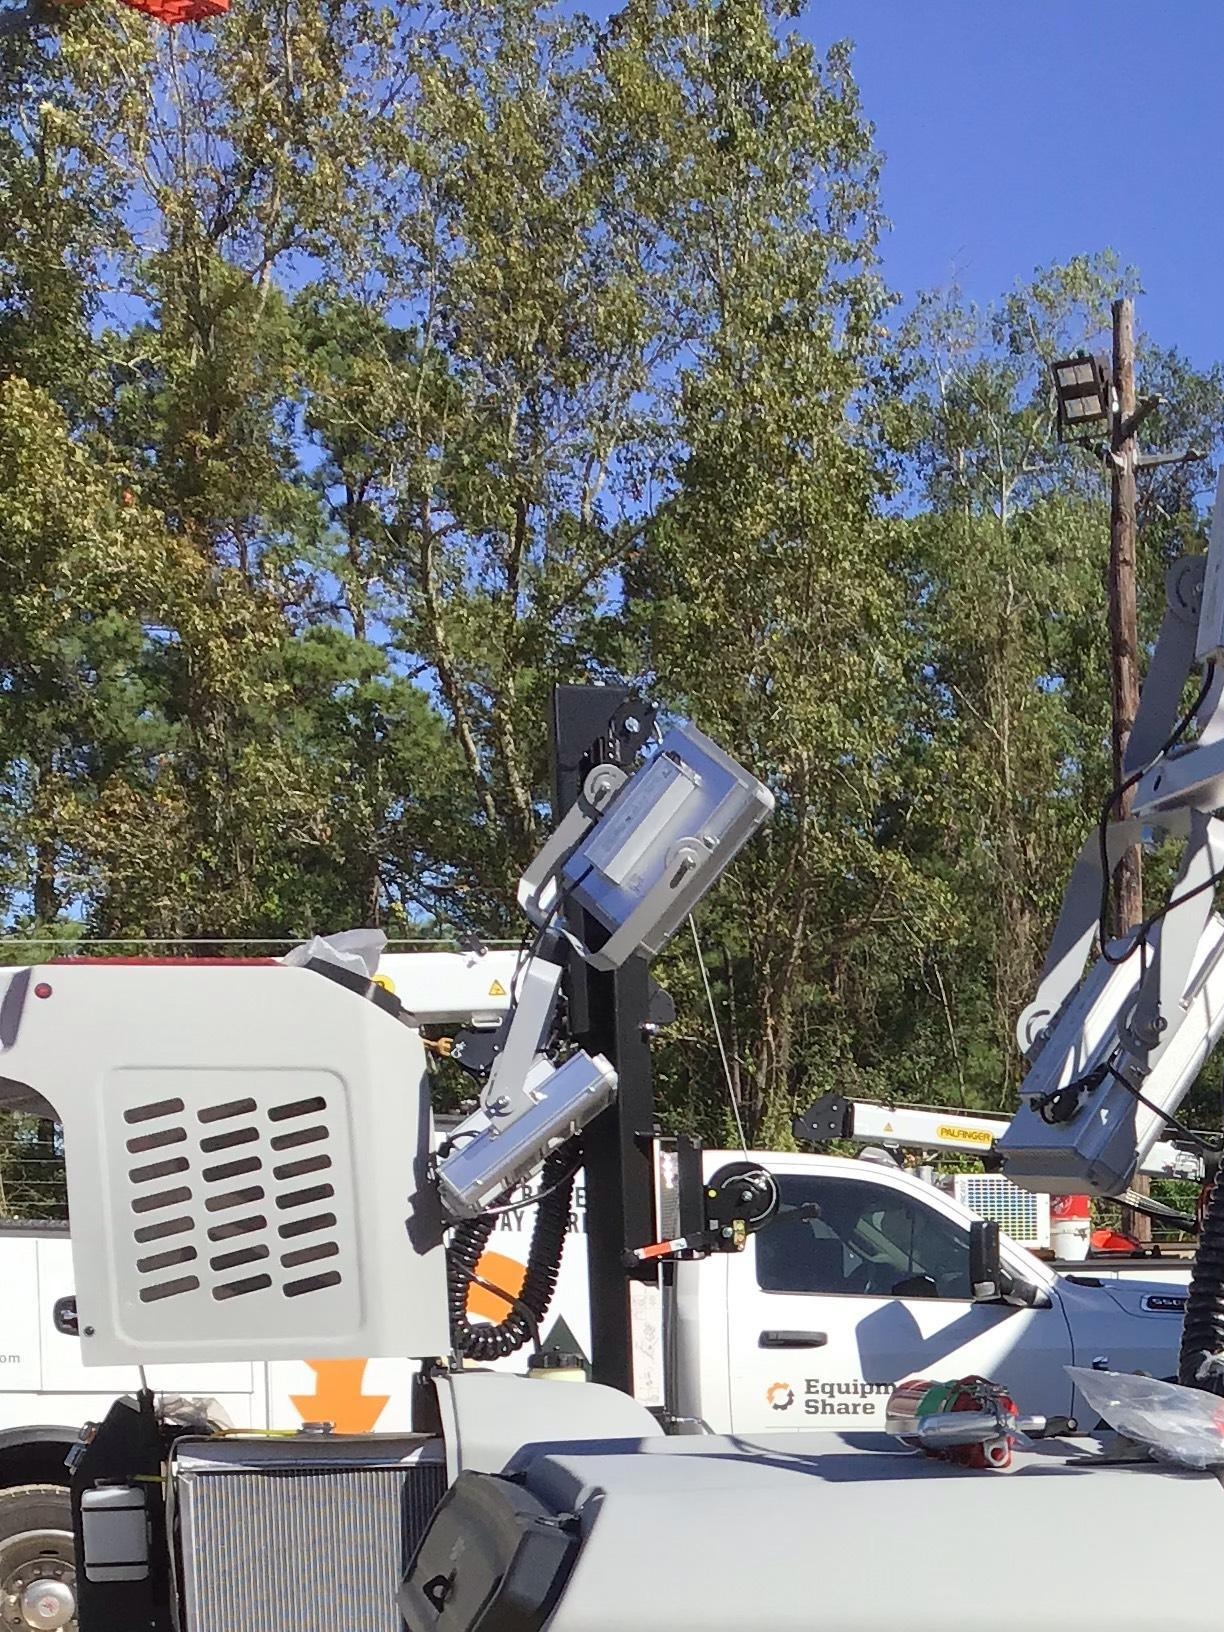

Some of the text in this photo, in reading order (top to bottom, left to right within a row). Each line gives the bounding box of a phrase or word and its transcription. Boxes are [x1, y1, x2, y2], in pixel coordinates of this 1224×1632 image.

[940, 1127, 991, 1141] PALFINGER
[804, 1379, 897, 1399] Equipm
[804, 1399, 876, 1415] Share
